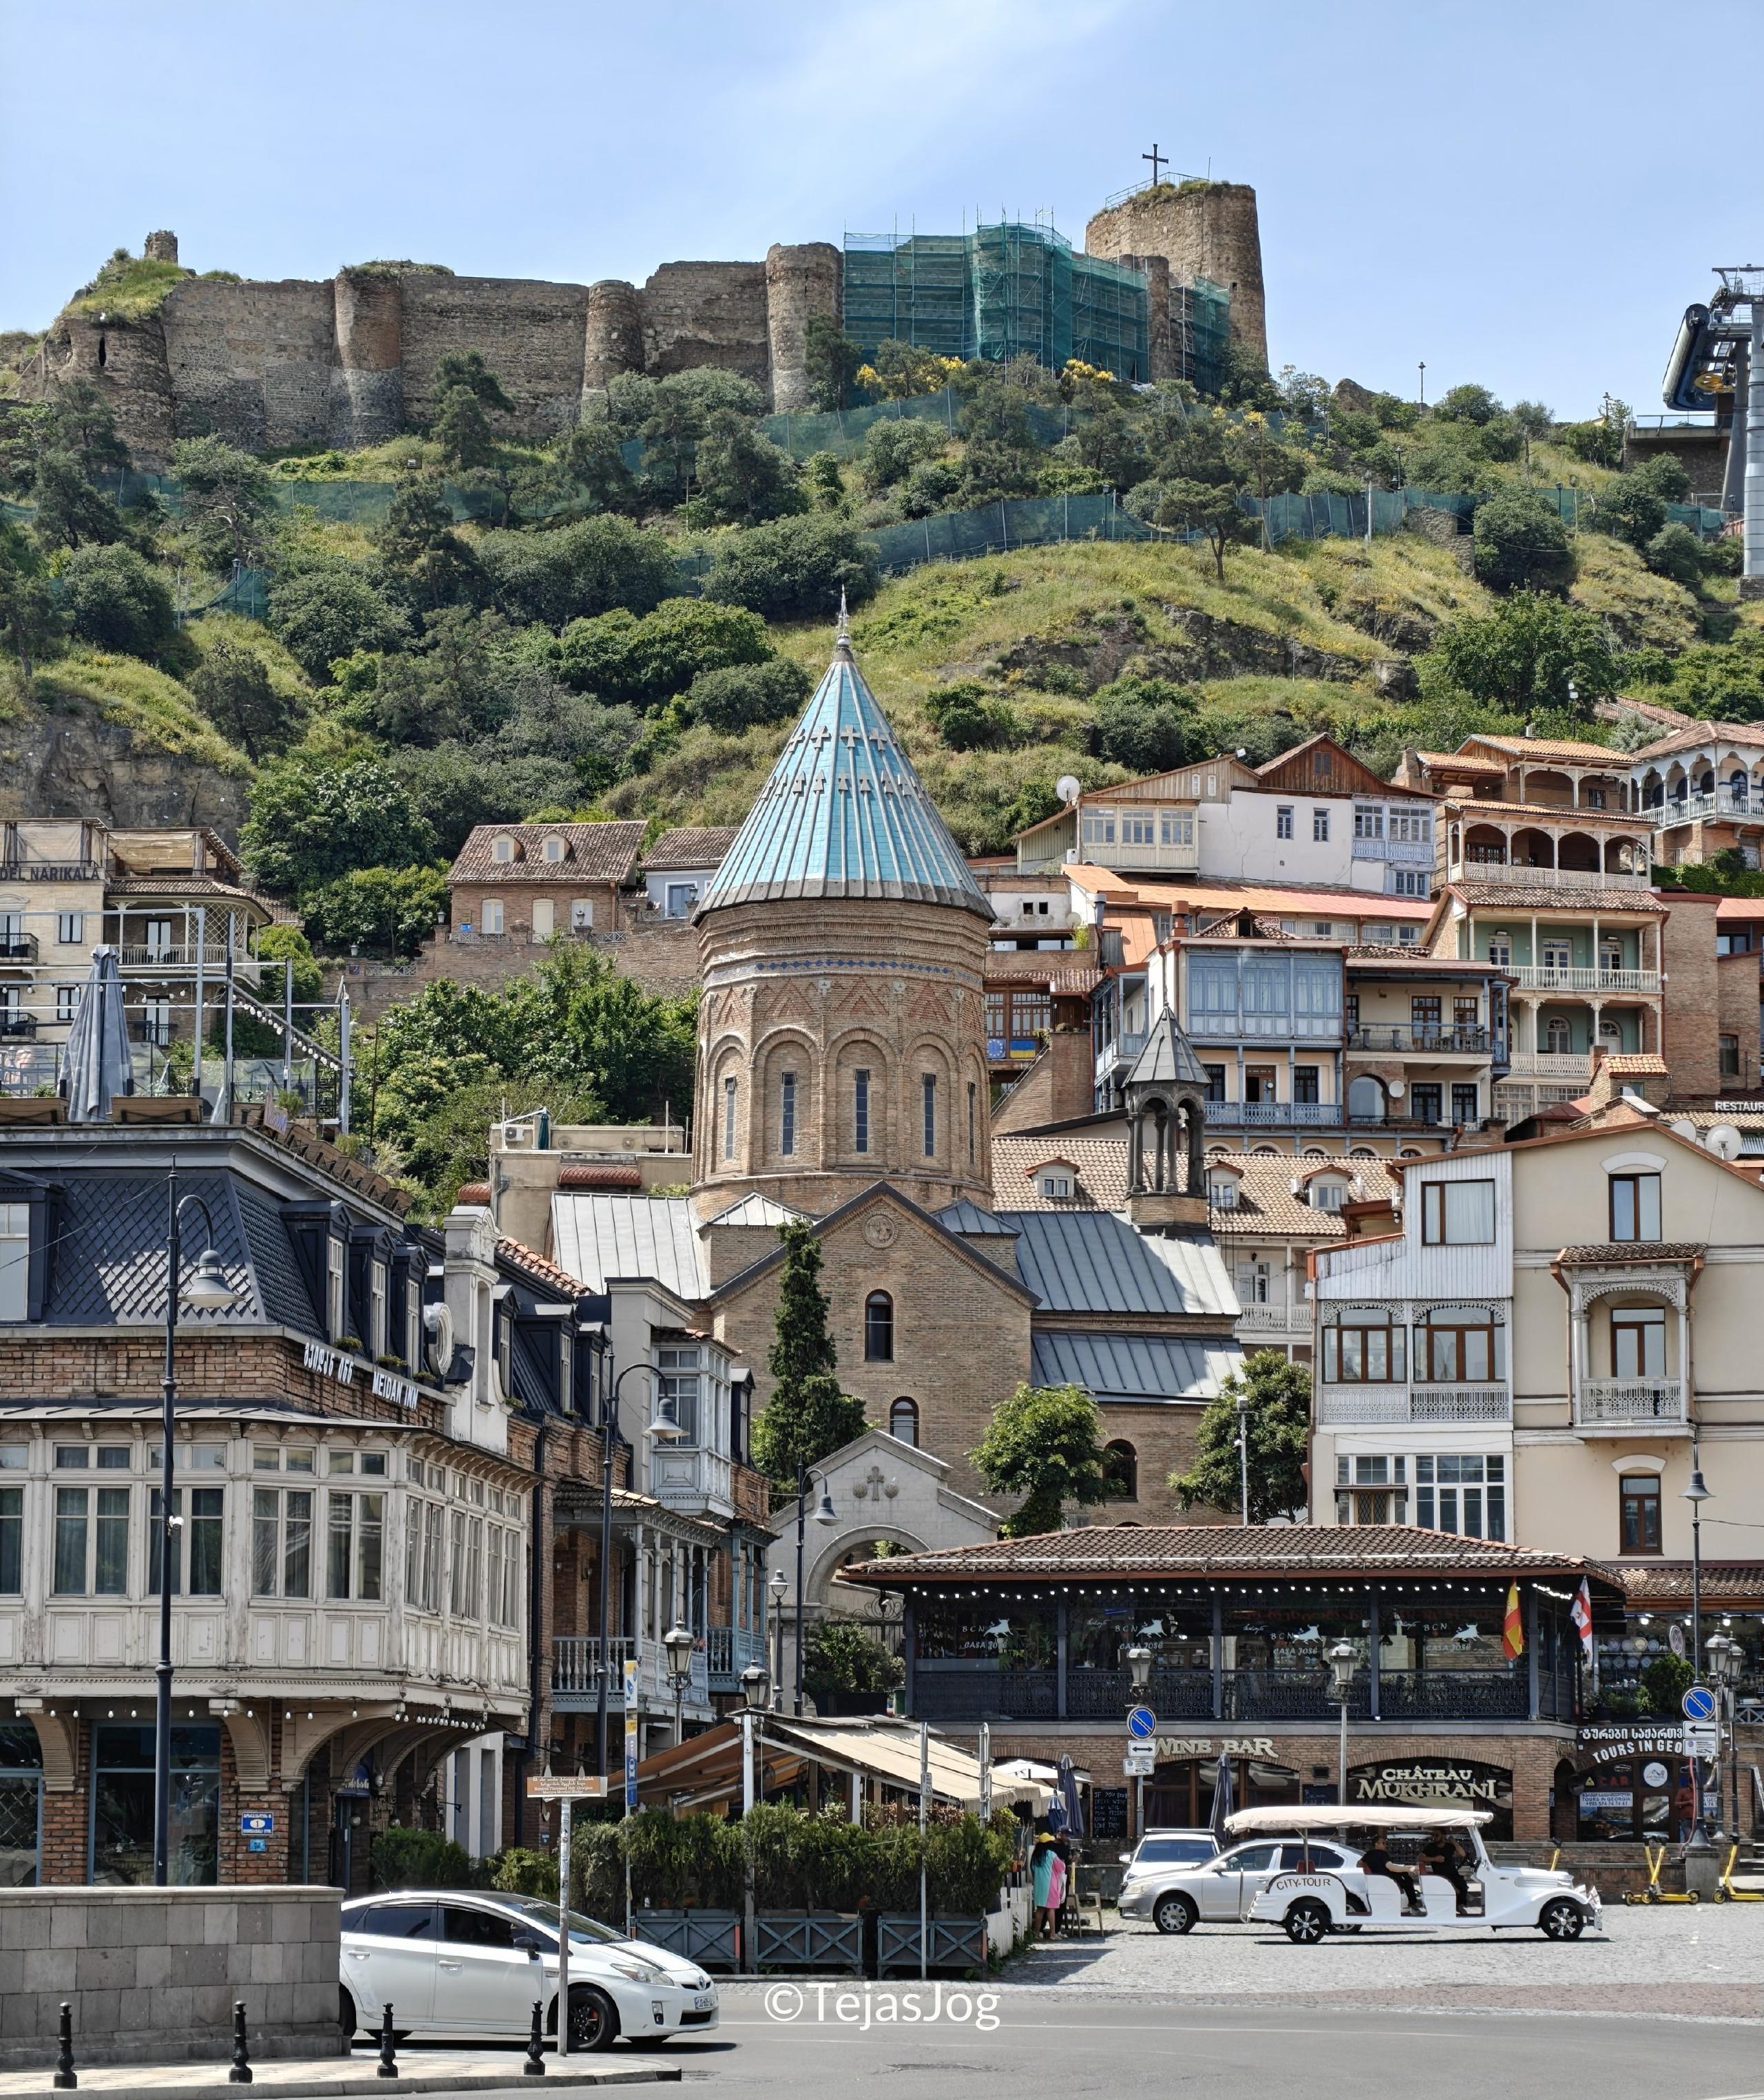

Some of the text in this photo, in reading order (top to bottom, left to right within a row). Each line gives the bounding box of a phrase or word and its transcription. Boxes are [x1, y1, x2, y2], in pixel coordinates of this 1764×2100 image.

[30, 867, 100, 881] NARIKALA
[1715, 1100, 1764, 1111] RESTAUR
[372, 1371, 419, 1410] MEIDAN INN
[1156, 1738, 1279, 1758] WINE BAR
[1592, 1742, 1635, 1764] TOURS
[1639, 1740, 1653, 1752] IN
[1382, 1765, 1473, 1781] CHÂTEAU
[1597, 1776, 1629, 1786] CAR
[1356, 1779, 1497, 1799] MUKHRANI
